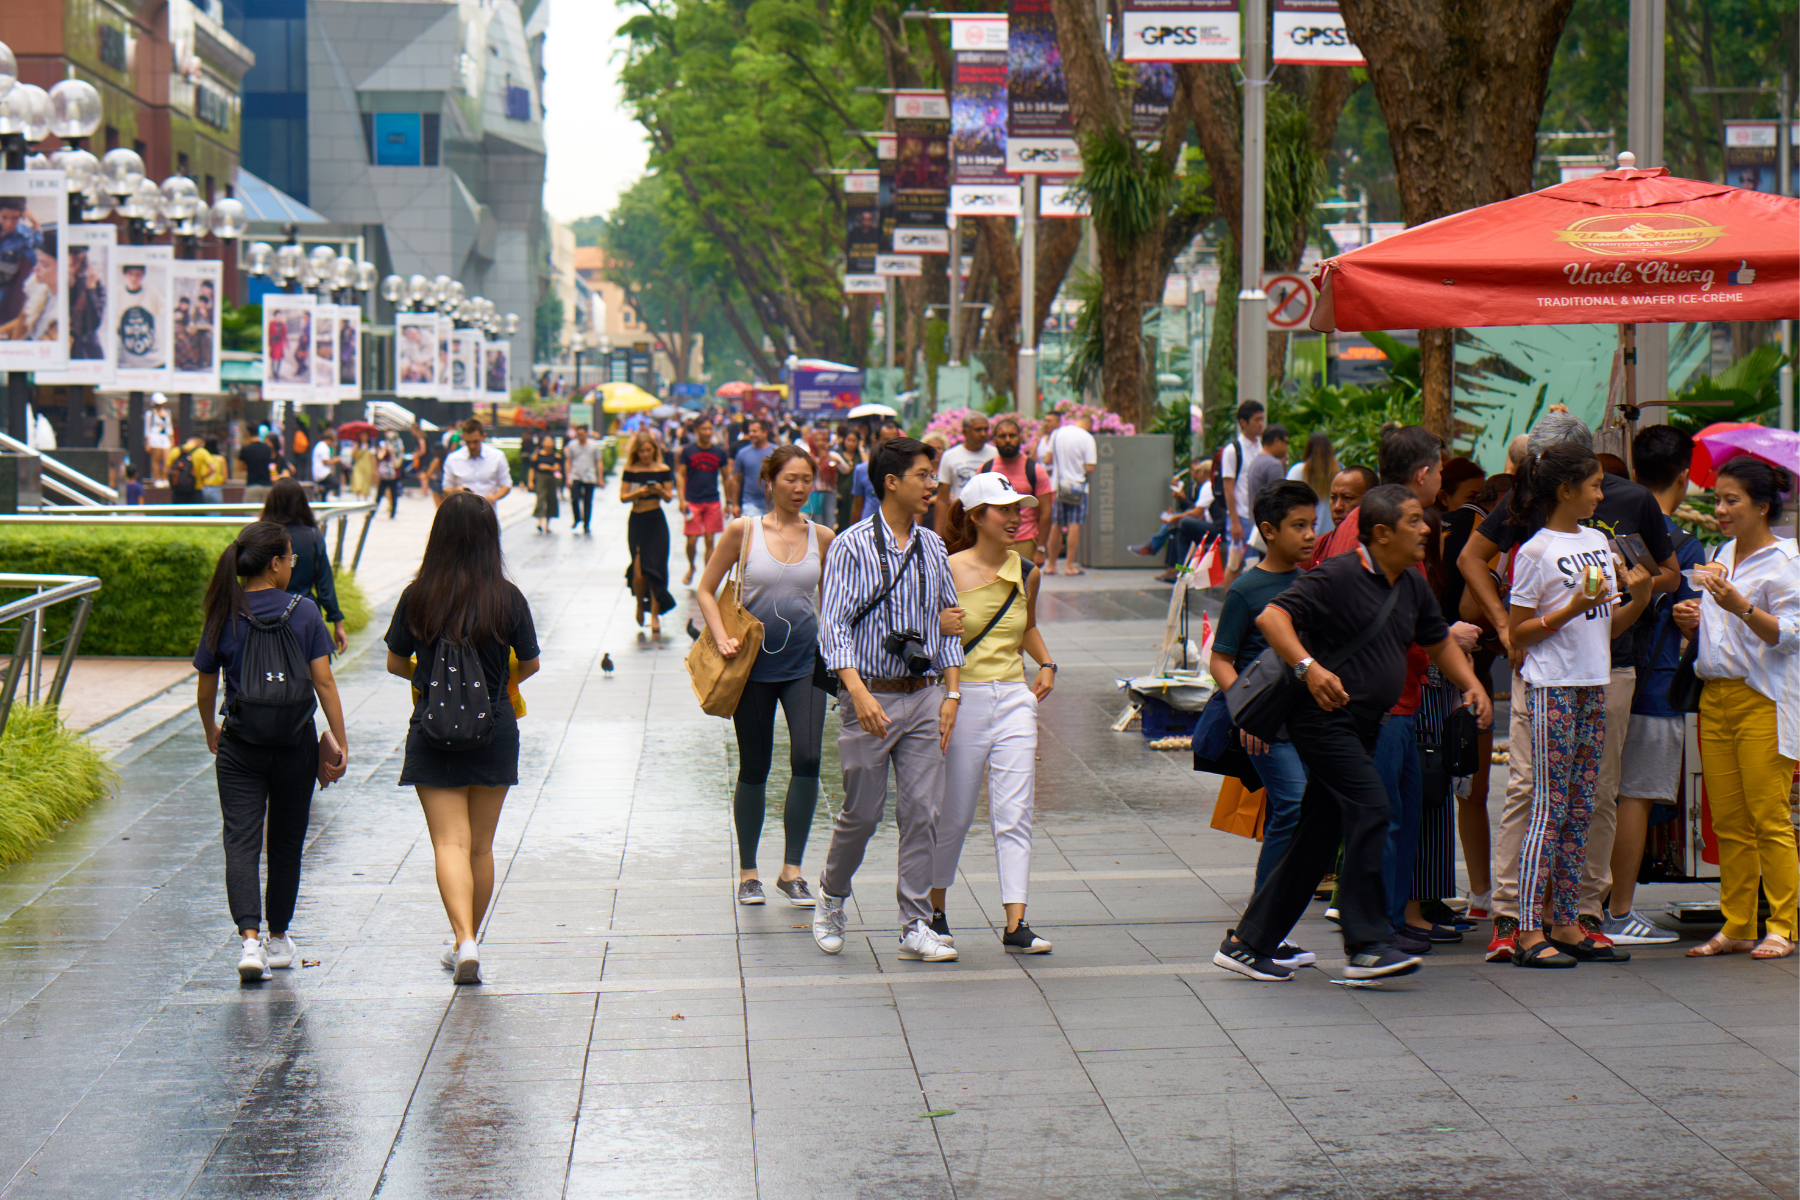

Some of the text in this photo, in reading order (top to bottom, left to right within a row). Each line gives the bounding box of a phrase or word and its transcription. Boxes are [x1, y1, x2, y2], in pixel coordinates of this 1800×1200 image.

[1141, 26, 1197, 45] GPSS
[1291, 26, 1347, 46] GPSS
[1048, 102, 1070, 114] Sept
[1019, 147, 1060, 163] GPSS
[961, 194, 995, 206] GPSS
[1574, 230, 1704, 240] Uncle Chieng
[1563, 260, 1716, 291] Uncle Chieng
[1537, 292, 1743, 307] TRADITIONAL & WAFER ICE-CRÈME
[1099, 463, 1115, 532] RECYCLING
